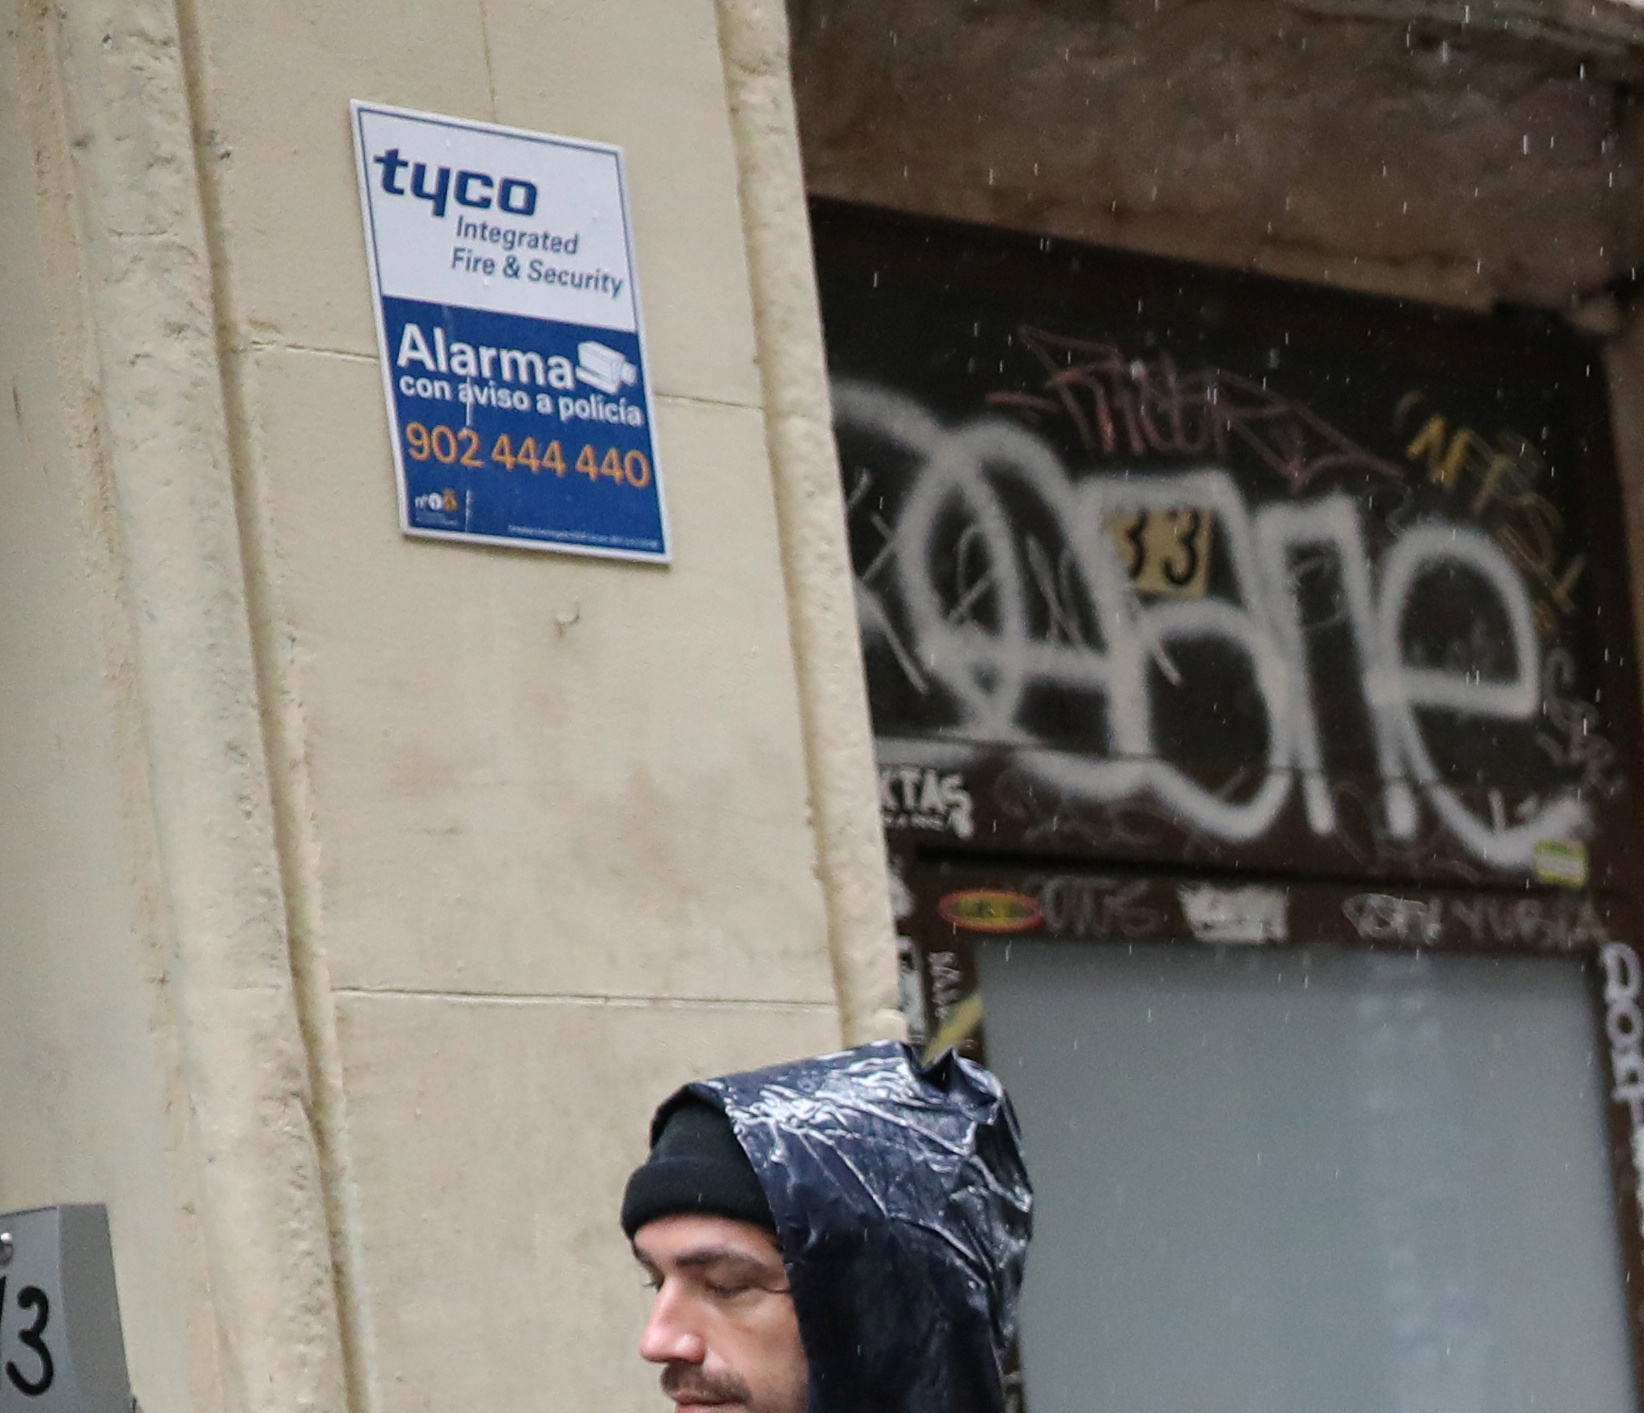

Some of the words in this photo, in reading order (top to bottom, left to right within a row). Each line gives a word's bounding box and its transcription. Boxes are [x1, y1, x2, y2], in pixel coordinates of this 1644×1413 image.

[373, 149, 538, 217] tyco
[456, 215, 579, 255] Integrated
[451, 248, 495, 277] Fire
[502, 255, 521, 279] &
[527, 261, 624, 298] Security
[397, 323, 575, 391] Alarma
[399, 375, 452, 402] con
[458, 379, 530, 411] aviso
[536, 393, 554, 416] a
[406, 422, 483, 468] 902
[491, 431, 566, 477] 444
[575, 444, 650, 488] 440
[0, 1274, 54, 1397] 3
